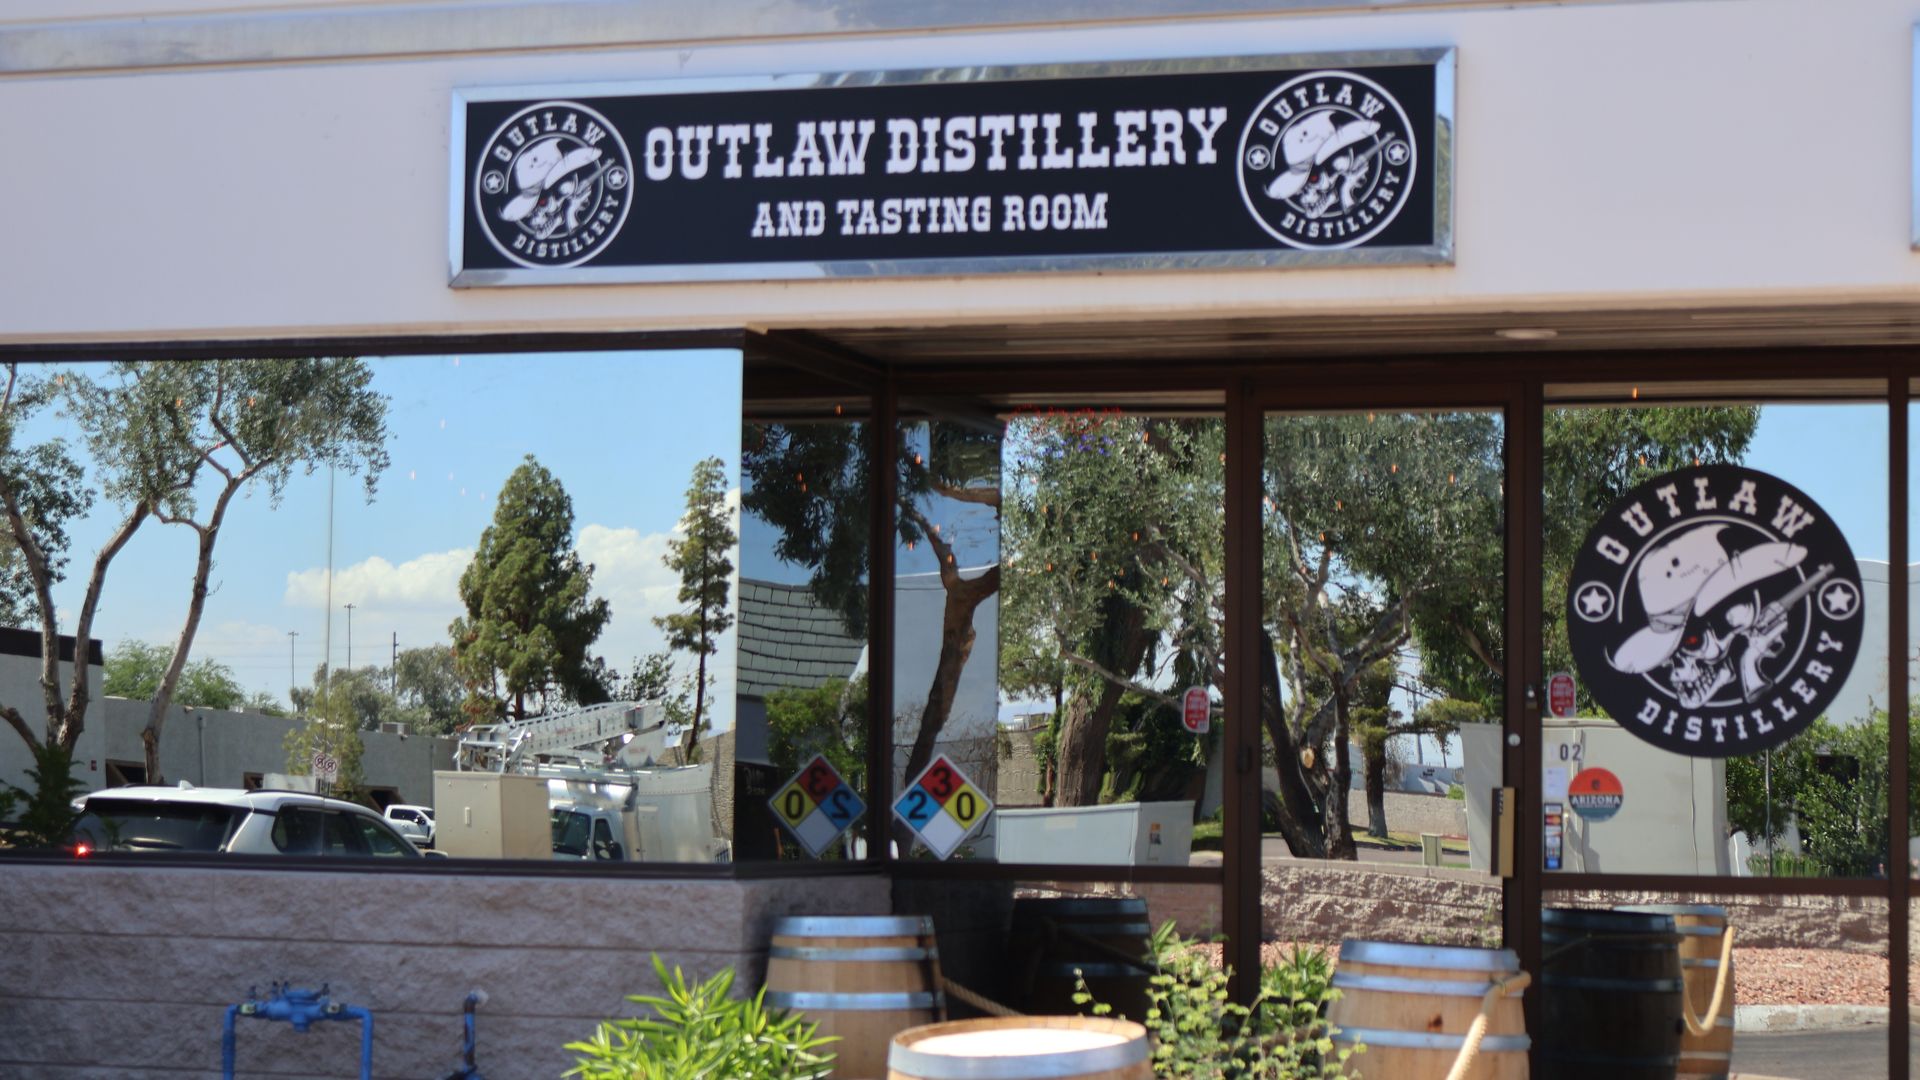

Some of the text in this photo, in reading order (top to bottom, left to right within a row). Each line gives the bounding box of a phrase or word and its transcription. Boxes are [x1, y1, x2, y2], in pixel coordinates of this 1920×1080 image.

[494, 113, 606, 162] OUTLAW
[1258, 83, 1384, 136] OUTLAW
[645, 107, 1227, 181] OUTLAW DISTILLERY
[513, 195, 618, 257] DISTILLERY
[751, 193, 1108, 237] AND TASTING ROOM
[1281, 171, 1399, 237] DISTILLERY
[1596, 477, 1815, 565] OUTLAW
[1637, 631, 1843, 742] DISTILLERY
[908, 791, 975, 821] 2 0
[932, 767, 952, 797] 3
